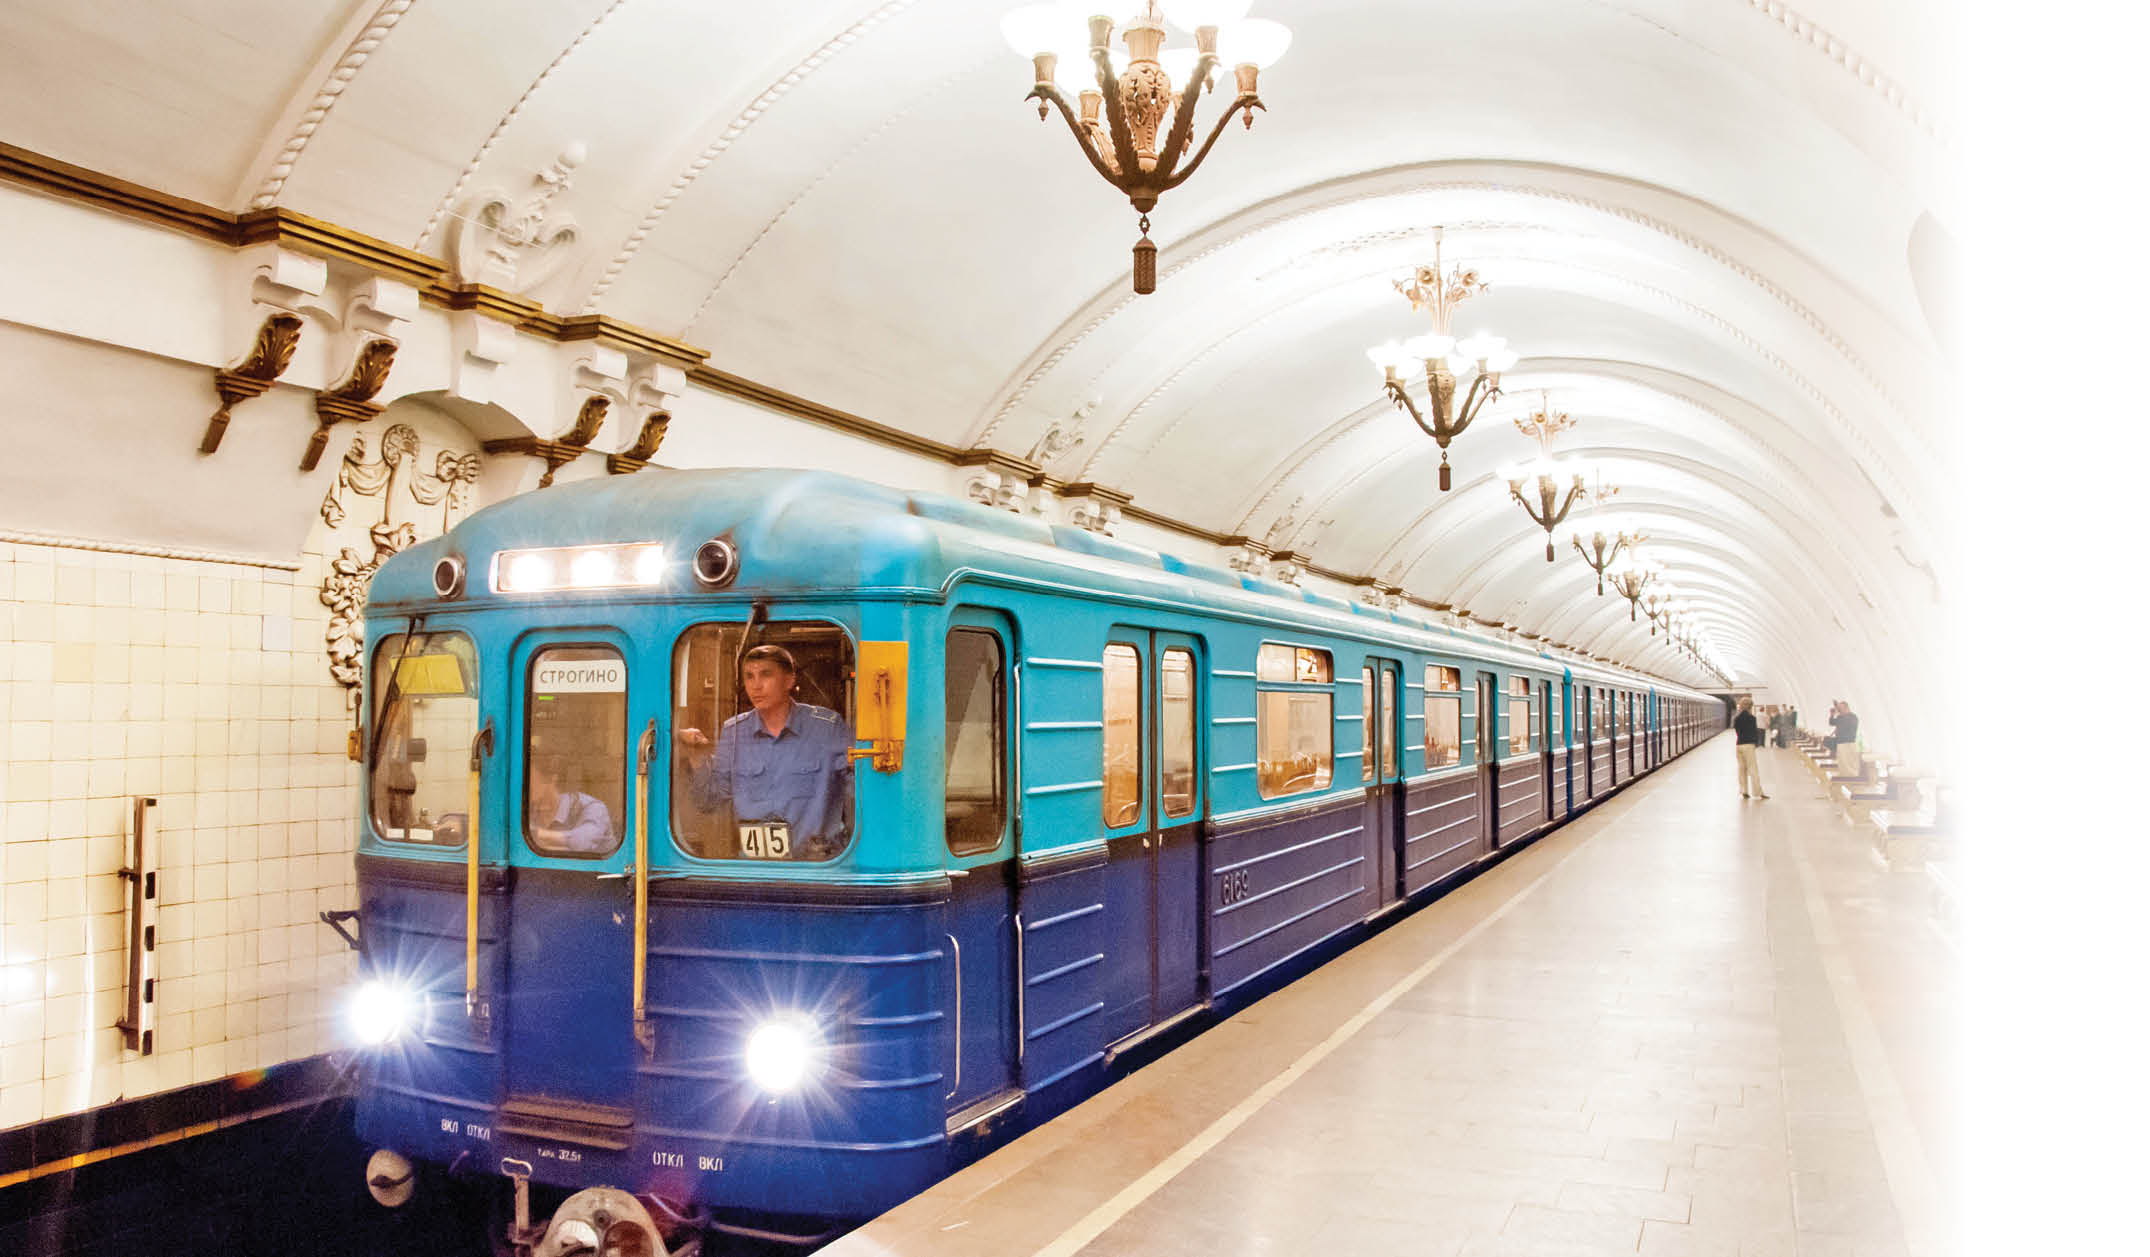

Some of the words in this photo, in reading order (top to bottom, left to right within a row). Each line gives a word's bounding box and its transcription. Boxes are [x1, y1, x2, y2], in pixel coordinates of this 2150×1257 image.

[540, 668, 617, 683] СТРОГИНО
[746, 826, 784, 856] 45
[1223, 869, 1248, 904] 6169
[441, 1119, 459, 1134] ВКЛ
[467, 1124, 491, 1141] ОТКЛ
[653, 1150, 684, 1168] ОТКЛ
[699, 1156, 723, 1171] ВКЛ
